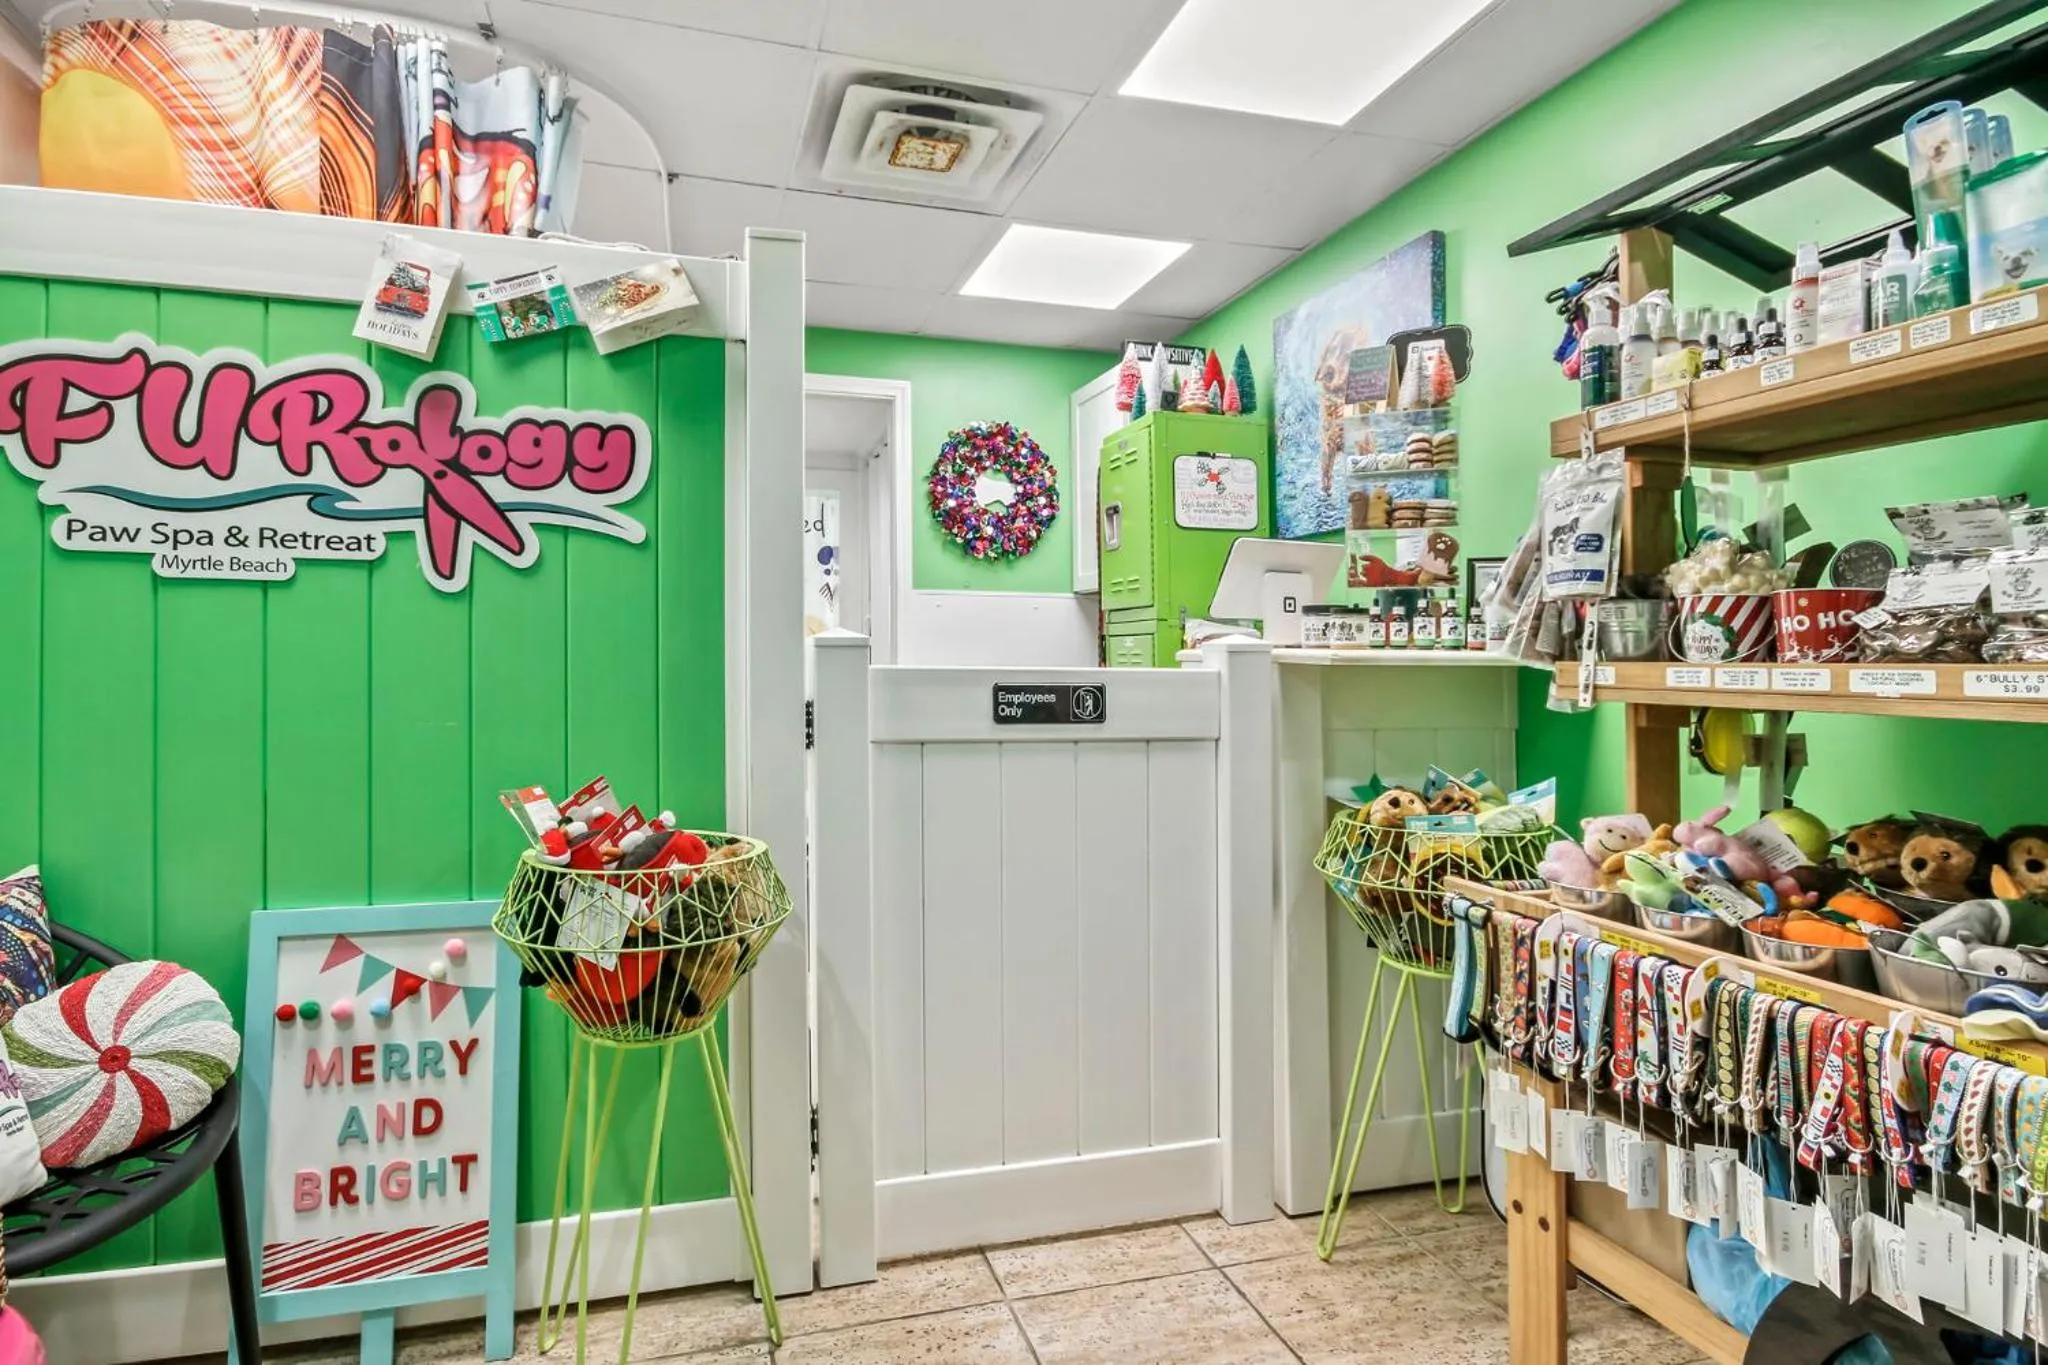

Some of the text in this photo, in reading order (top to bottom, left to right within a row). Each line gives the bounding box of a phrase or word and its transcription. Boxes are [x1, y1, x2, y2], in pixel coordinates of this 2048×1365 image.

[0, 347, 637, 494] FURology
[65, 518, 377, 553] Paw Spa & Retreat
[159, 553, 288, 574] Myrtle Beach
[1781, 614, 1810, 634] HO
[2003, 684, 2041, 693] $3.99
[2036, 674, 2048, 684] S
[998, 691, 1056, 705] Employees
[998, 705, 1022, 718] Only
[304, 1038, 479, 1089] MERRY
[337, 1097, 444, 1146] AND
[292, 1153, 479, 1213] BRIGHT
